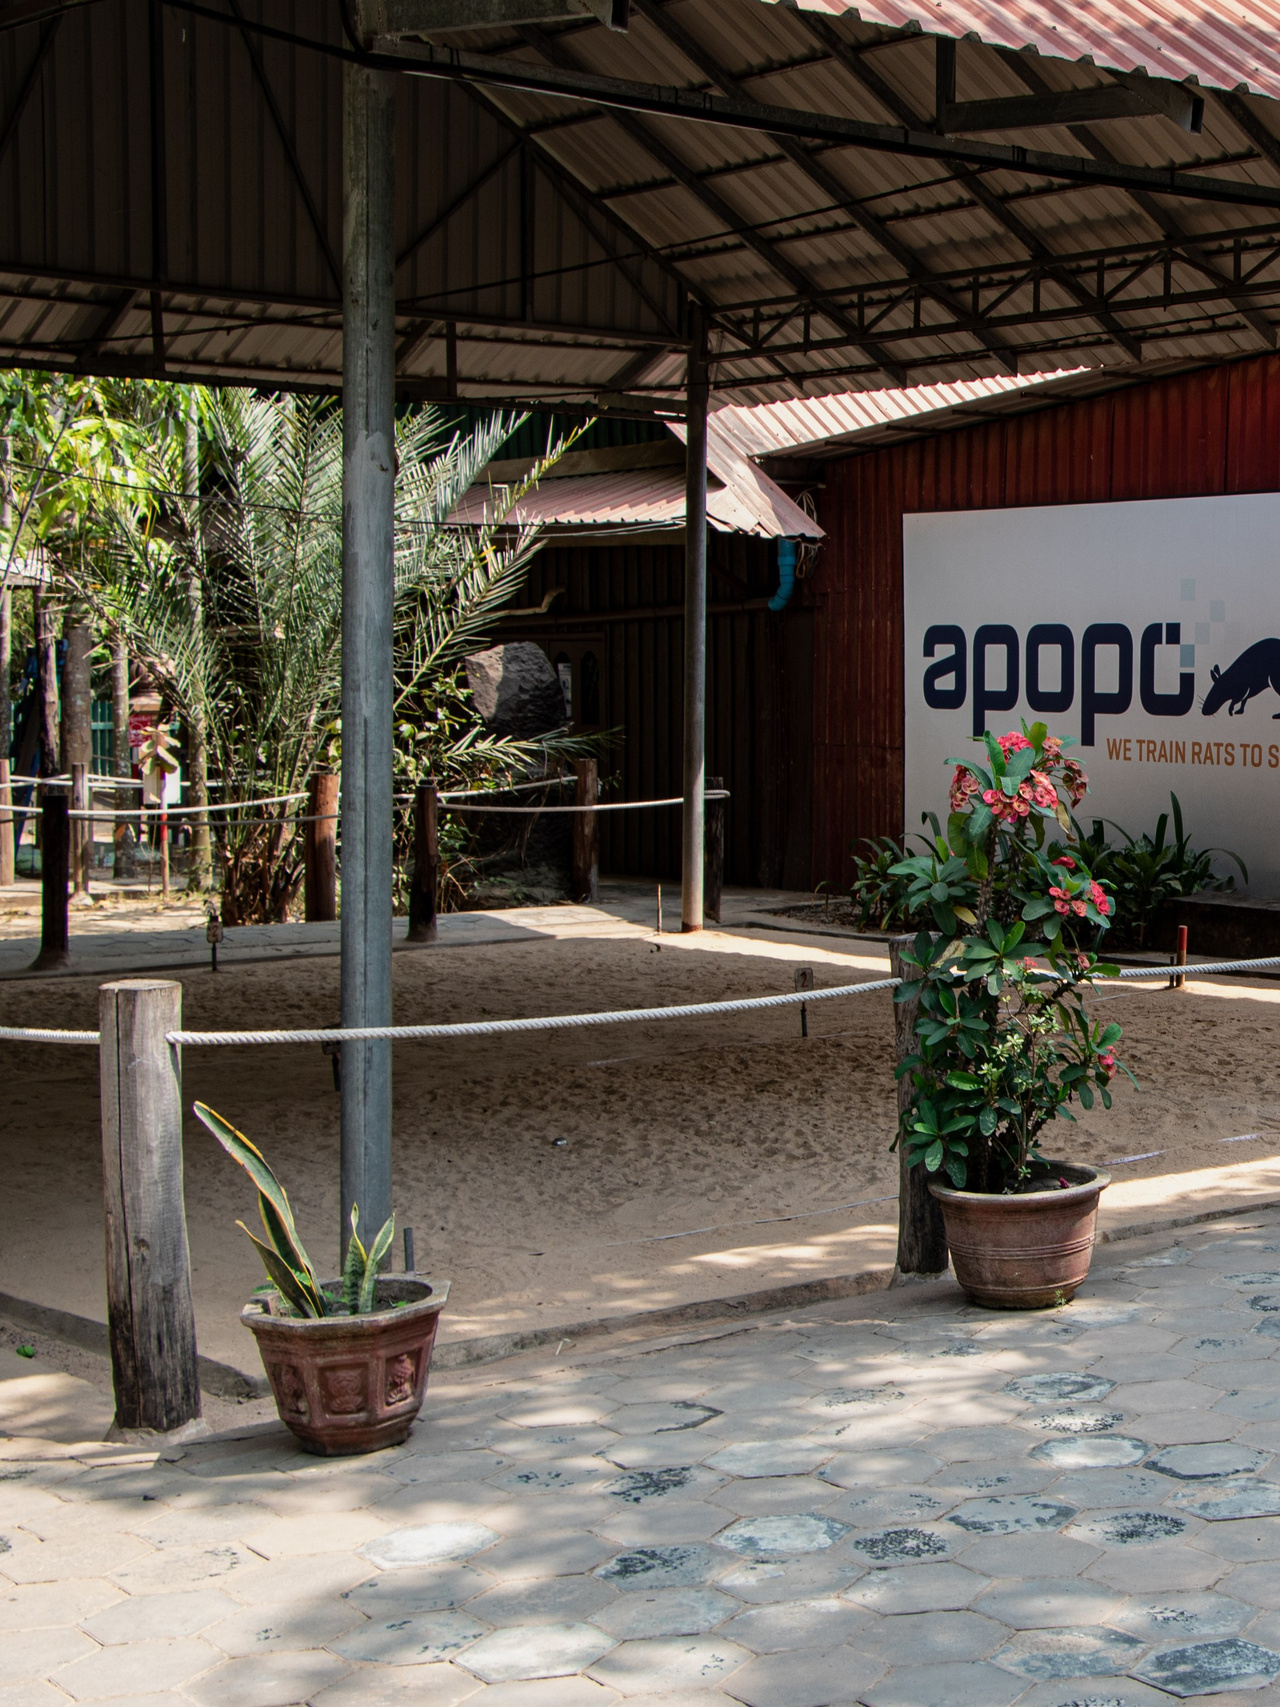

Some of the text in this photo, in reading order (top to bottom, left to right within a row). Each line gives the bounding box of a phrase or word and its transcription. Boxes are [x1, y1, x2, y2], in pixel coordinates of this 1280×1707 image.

[1106, 738, 1132, 761] WE
[1136, 739, 1185, 764] TRAIN
[1191, 741, 1236, 766] RATS
[1239, 743, 1262, 768] TO
[800, 971, 809, 988] 2
